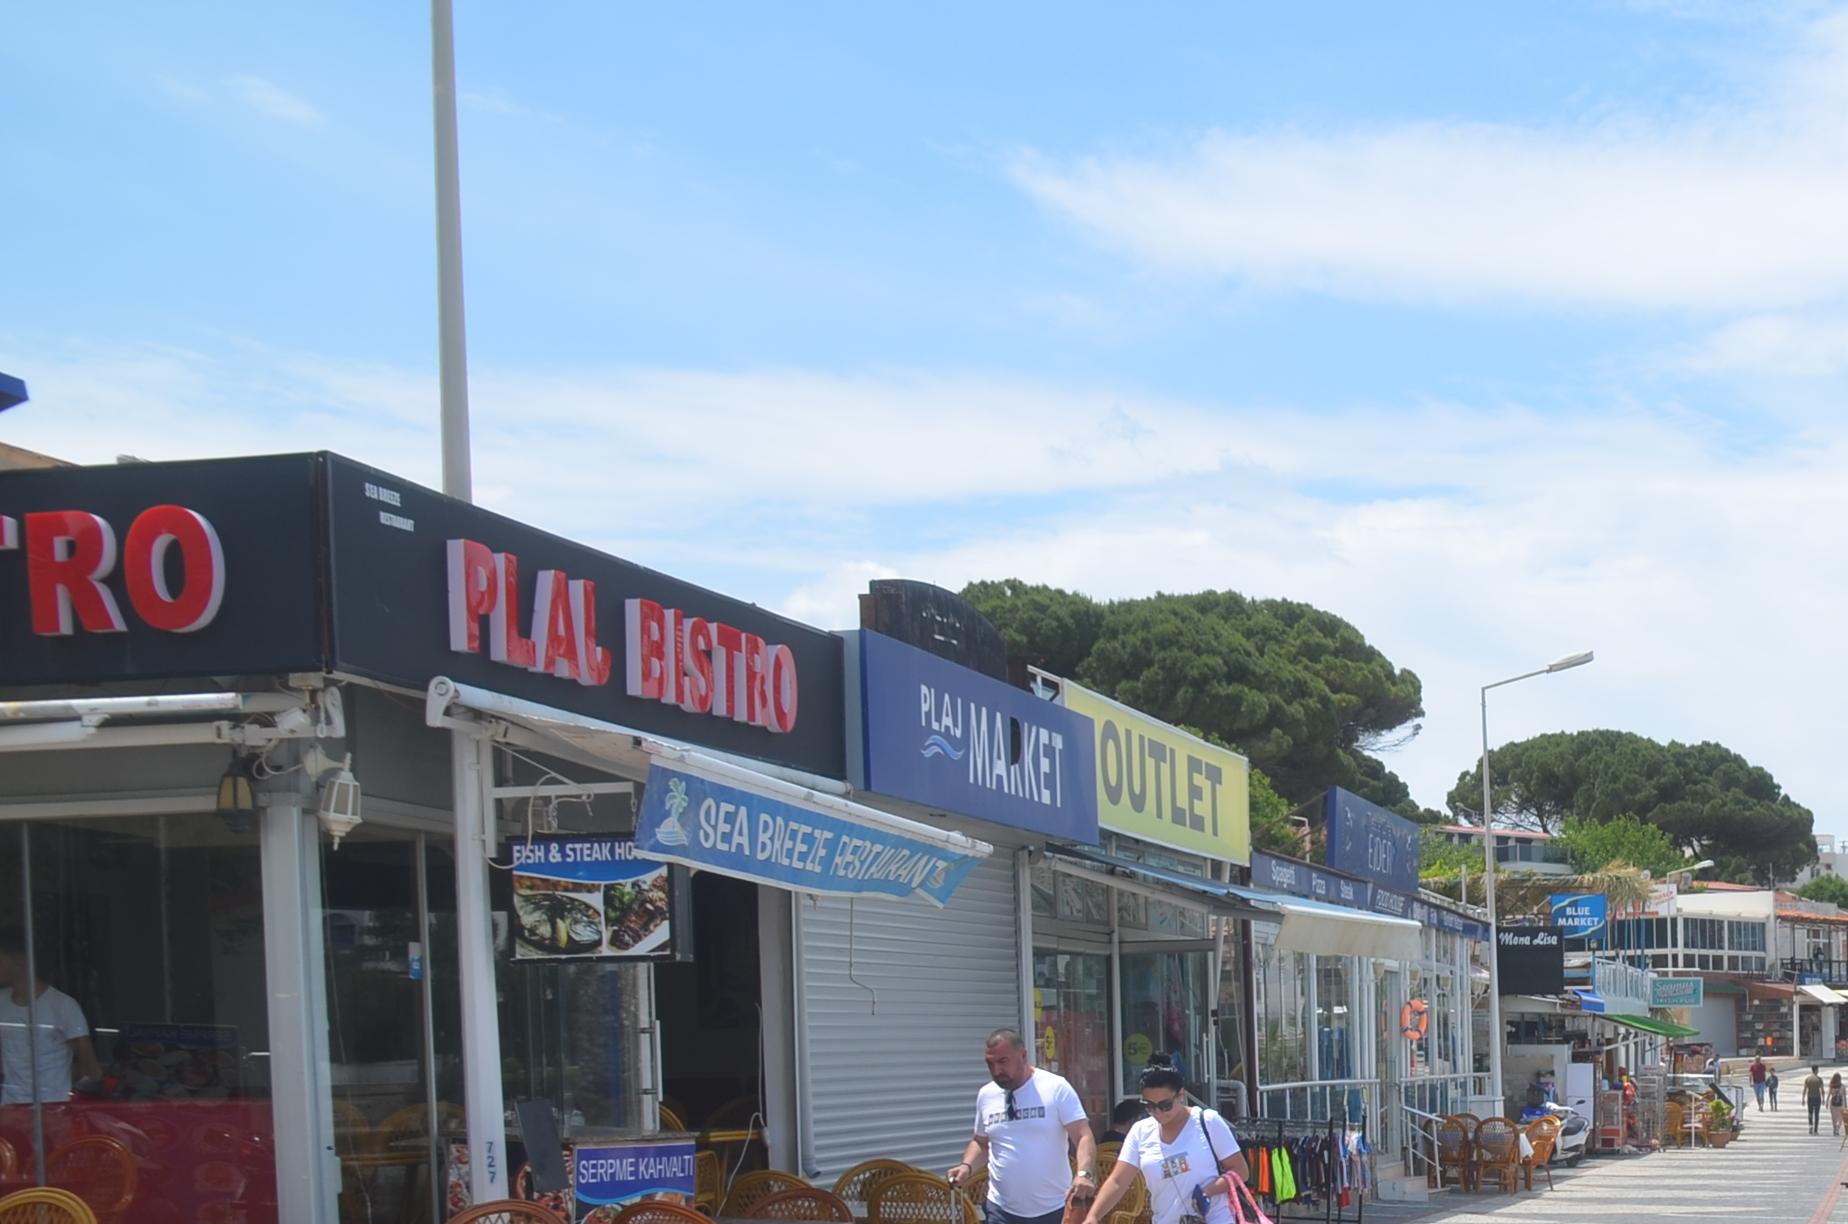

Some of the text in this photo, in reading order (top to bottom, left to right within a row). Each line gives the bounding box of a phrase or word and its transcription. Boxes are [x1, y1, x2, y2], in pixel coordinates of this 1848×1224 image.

[0, 504, 226, 636] RO
[624, 597, 798, 734] BISTRO
[920, 683, 1064, 808] PLAJ MARKET
[1100, 719, 1223, 838] OUTLET
[512, 844, 545, 866] FISH
[549, 842, 563, 864] &
[565, 841, 612, 863] STEAK
[699, 797, 751, 856] SEA
[757, 812, 835, 873] BREEZE
[1557, 916, 1600, 927] MARKET
[1565, 906, 1591, 916] BLUE
[1499, 931, 1558, 946] Mona Lisa
[578, 1154, 694, 1184] SERPME KAHVALTI
